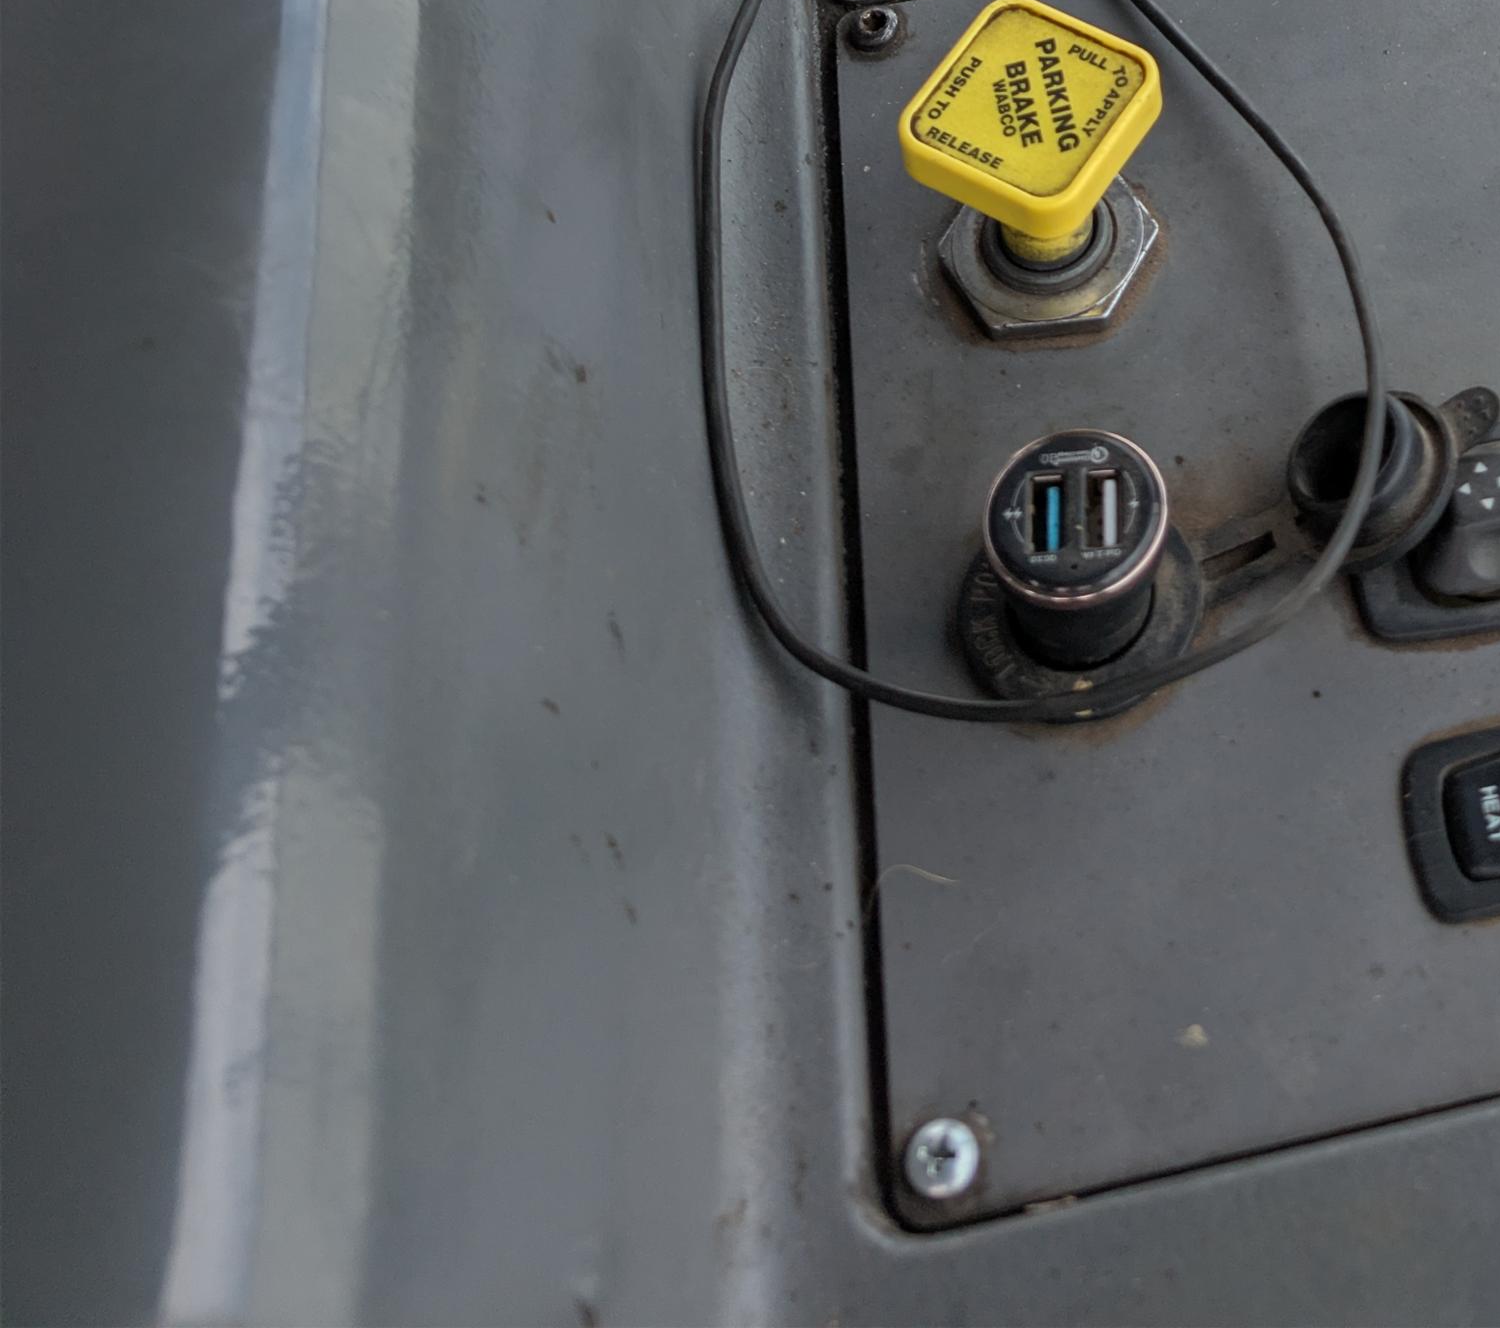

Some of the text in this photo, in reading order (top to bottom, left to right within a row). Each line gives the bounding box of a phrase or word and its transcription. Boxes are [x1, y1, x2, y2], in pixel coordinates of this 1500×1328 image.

[926, 56, 1004, 170] PUSH TO RELEASE
[992, 80, 1016, 138] WABCO
[1005, 60, 1043, 148] BRAKE
[1034, 37, 1080, 153] PARKING
[1068, 44, 1129, 139] PULL TO APPLY
